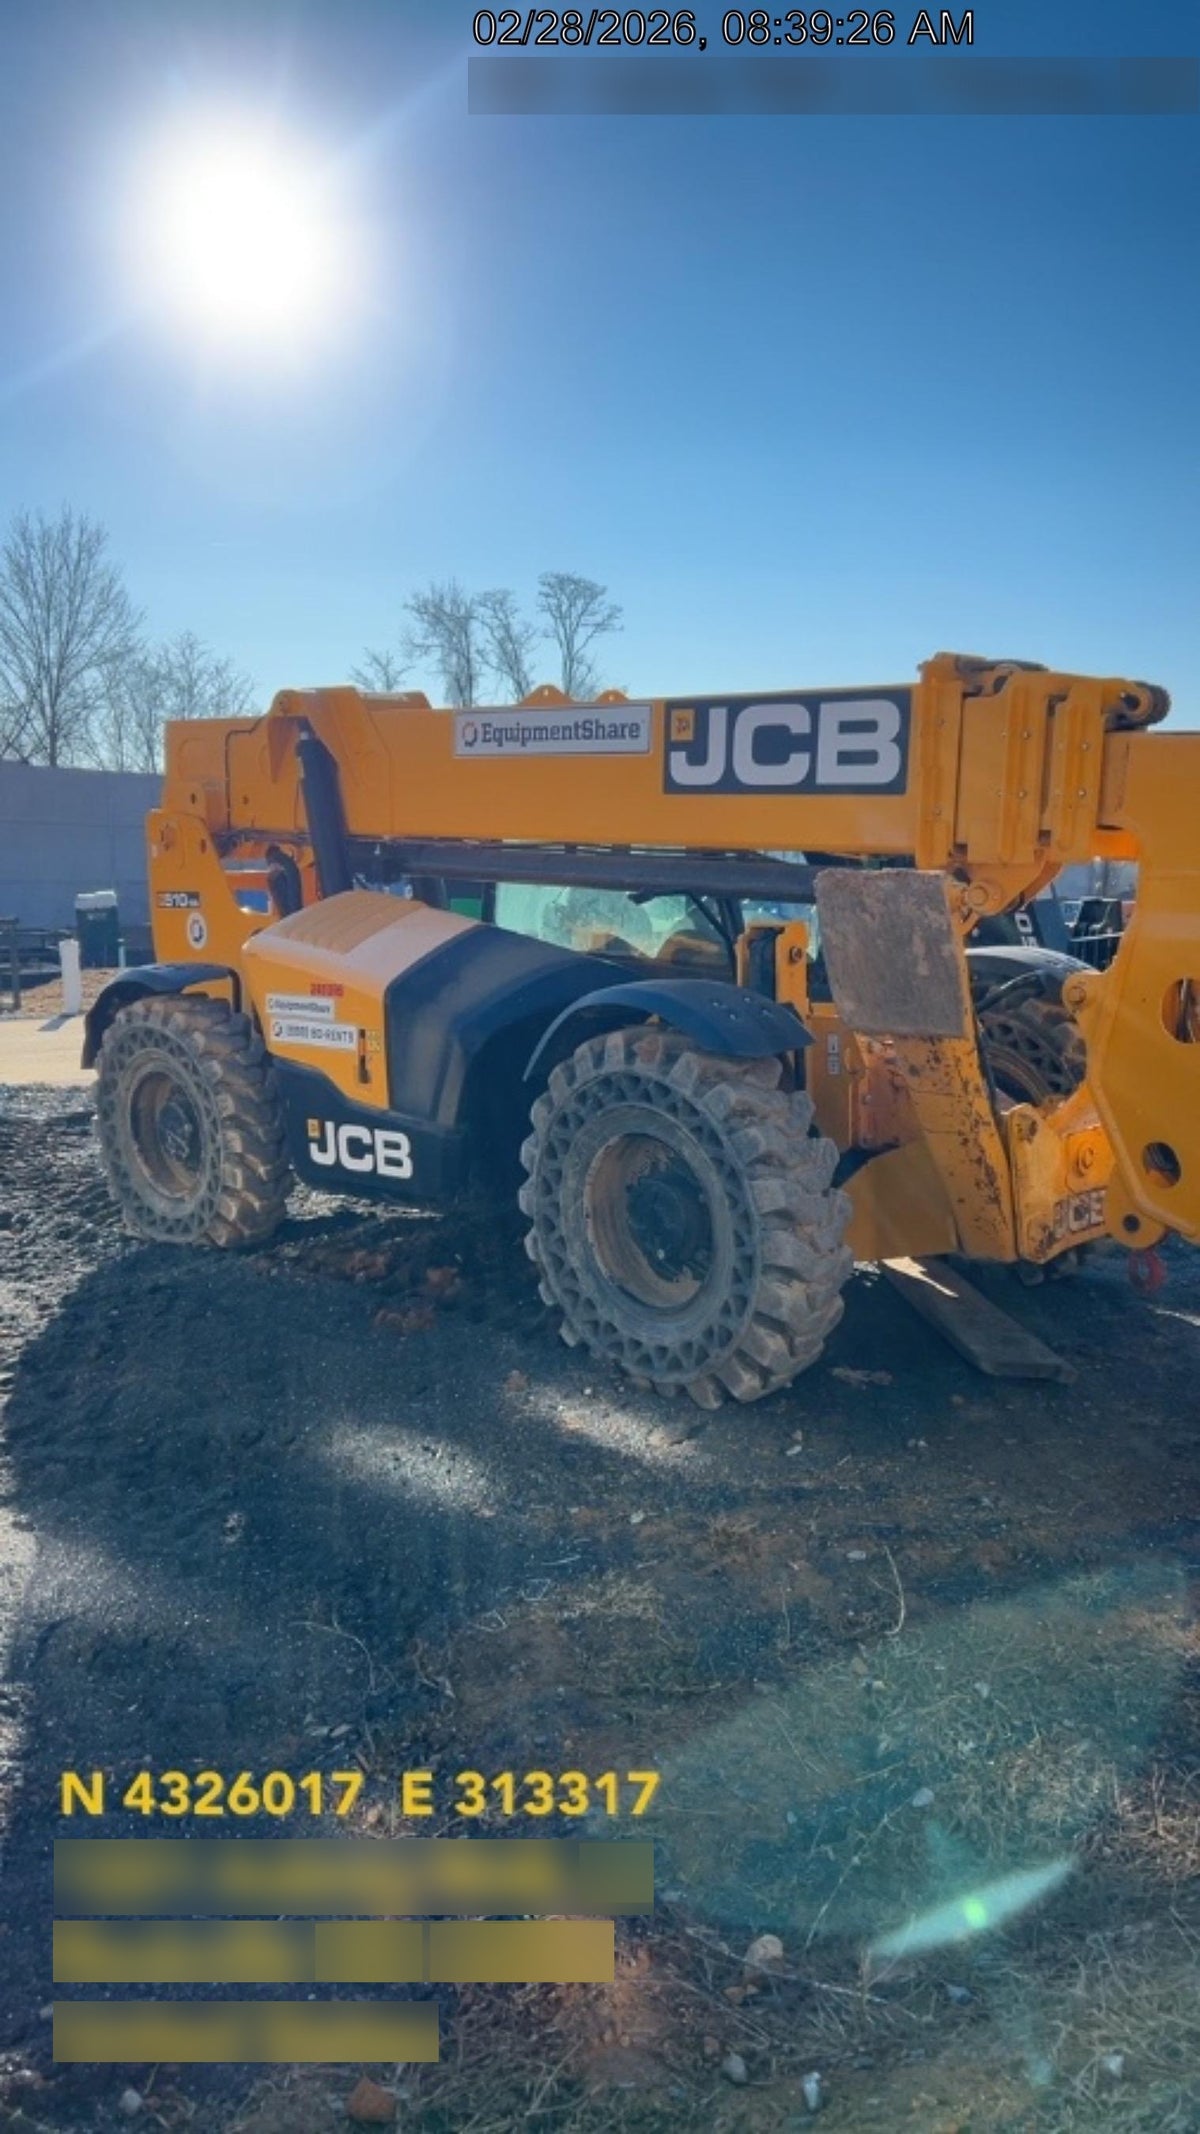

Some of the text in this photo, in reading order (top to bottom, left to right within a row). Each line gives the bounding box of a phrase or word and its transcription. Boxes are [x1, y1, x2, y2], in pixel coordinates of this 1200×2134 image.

[481, 719, 641, 747] EquipmentShare
[670, 699, 901, 786] JCB
[309, 1120, 413, 1179] JCB
